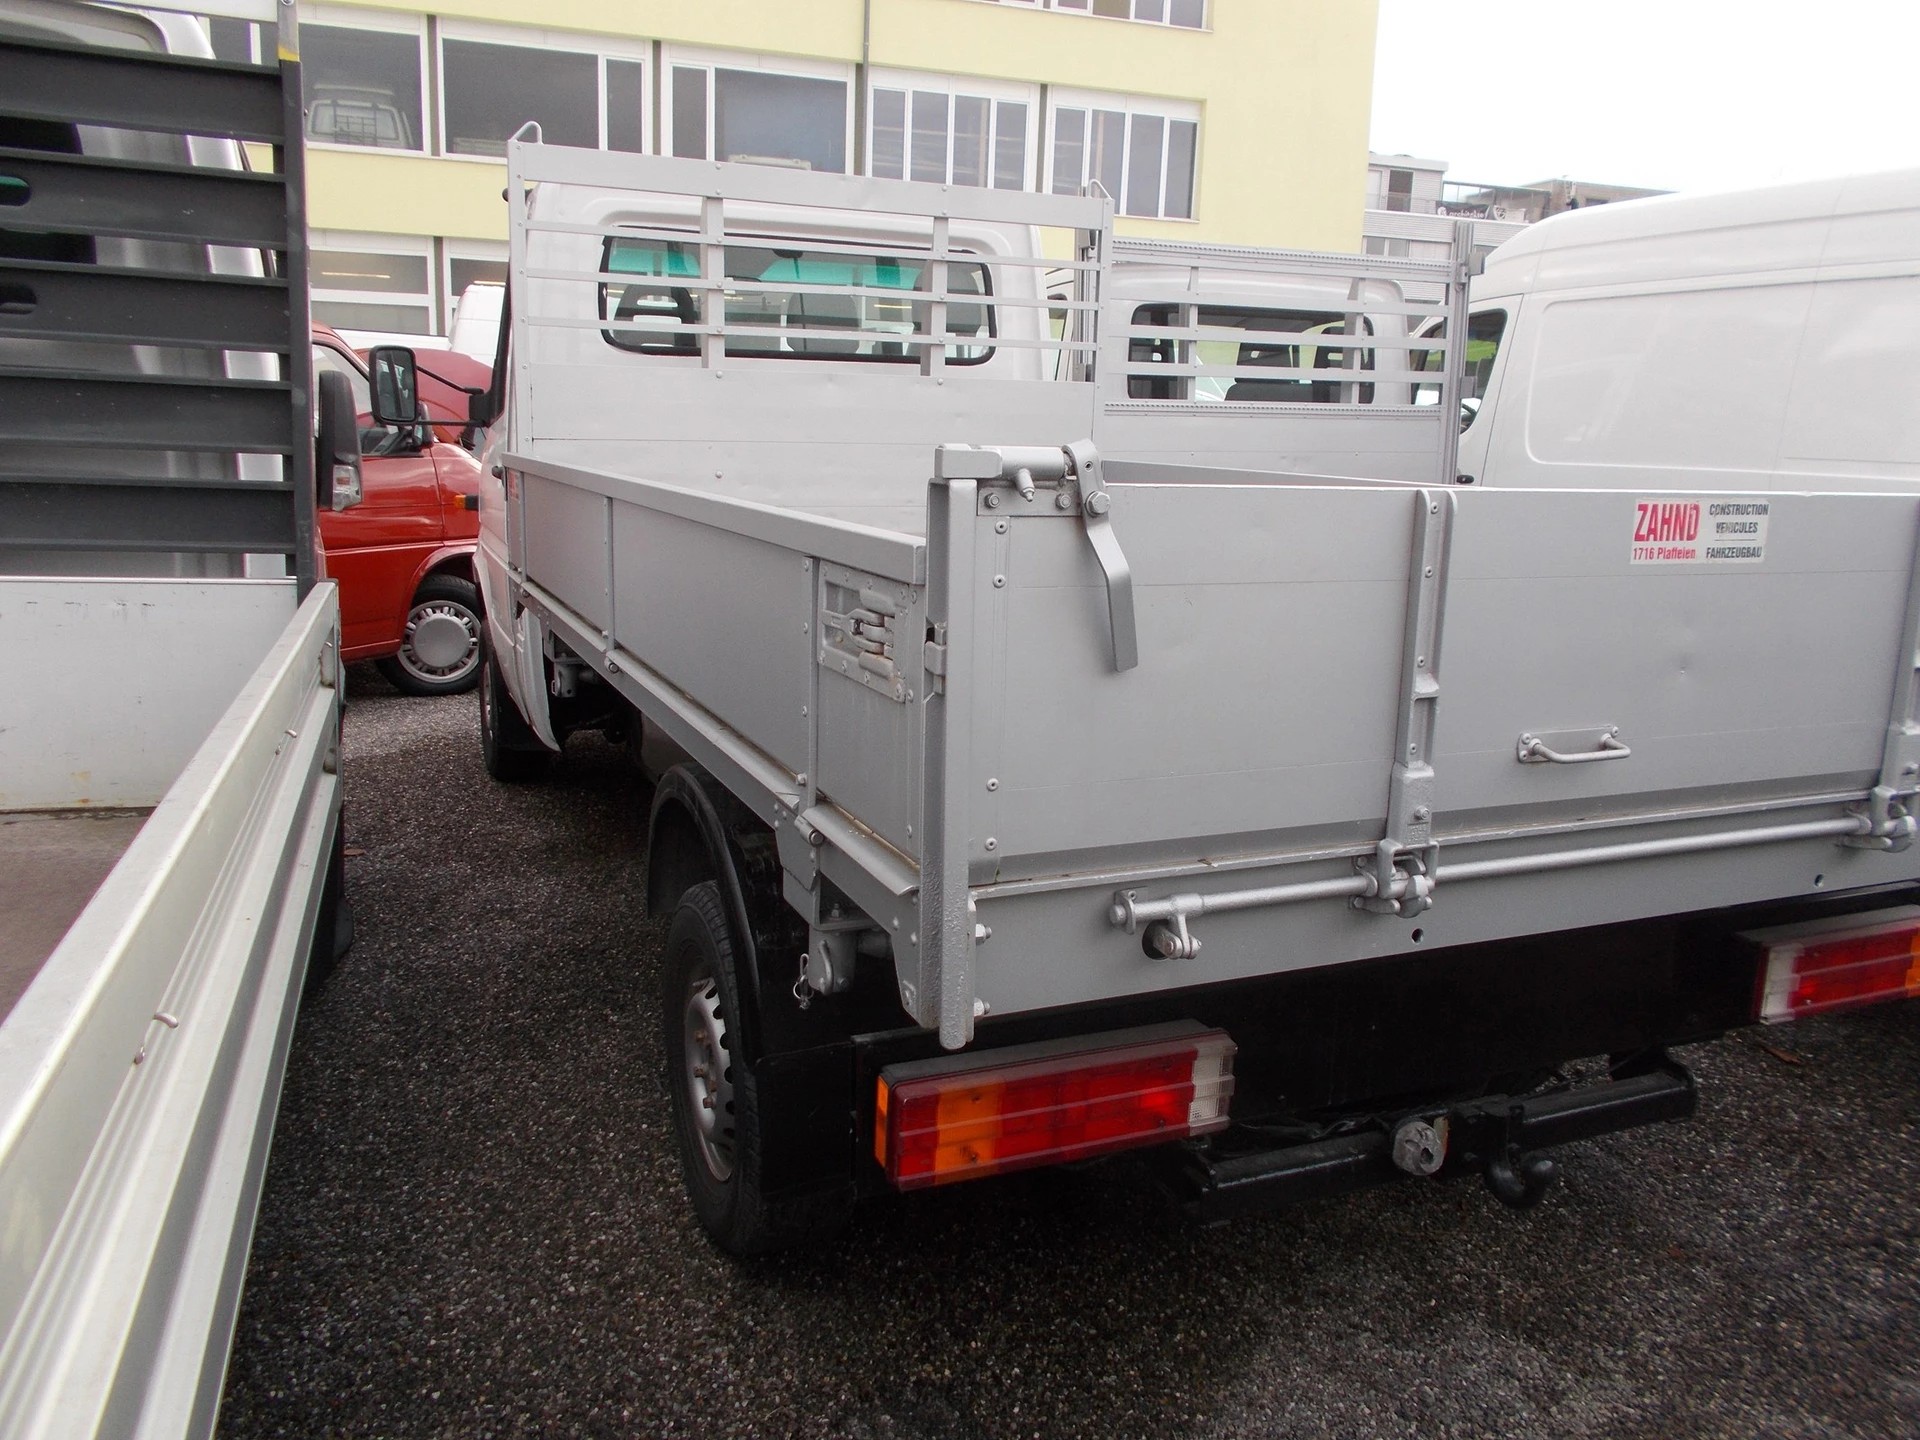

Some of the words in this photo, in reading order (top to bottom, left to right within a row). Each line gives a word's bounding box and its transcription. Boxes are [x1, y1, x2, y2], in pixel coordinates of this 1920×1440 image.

[1709, 503, 1769, 516] CONSTRUCTION
[1634, 503, 1701, 542] ZAHND
[1633, 547, 1655, 560] 1716
[1656, 546, 1696, 560] Plaffeien
[1706, 546, 1762, 559] FAHRZEUGBAU
